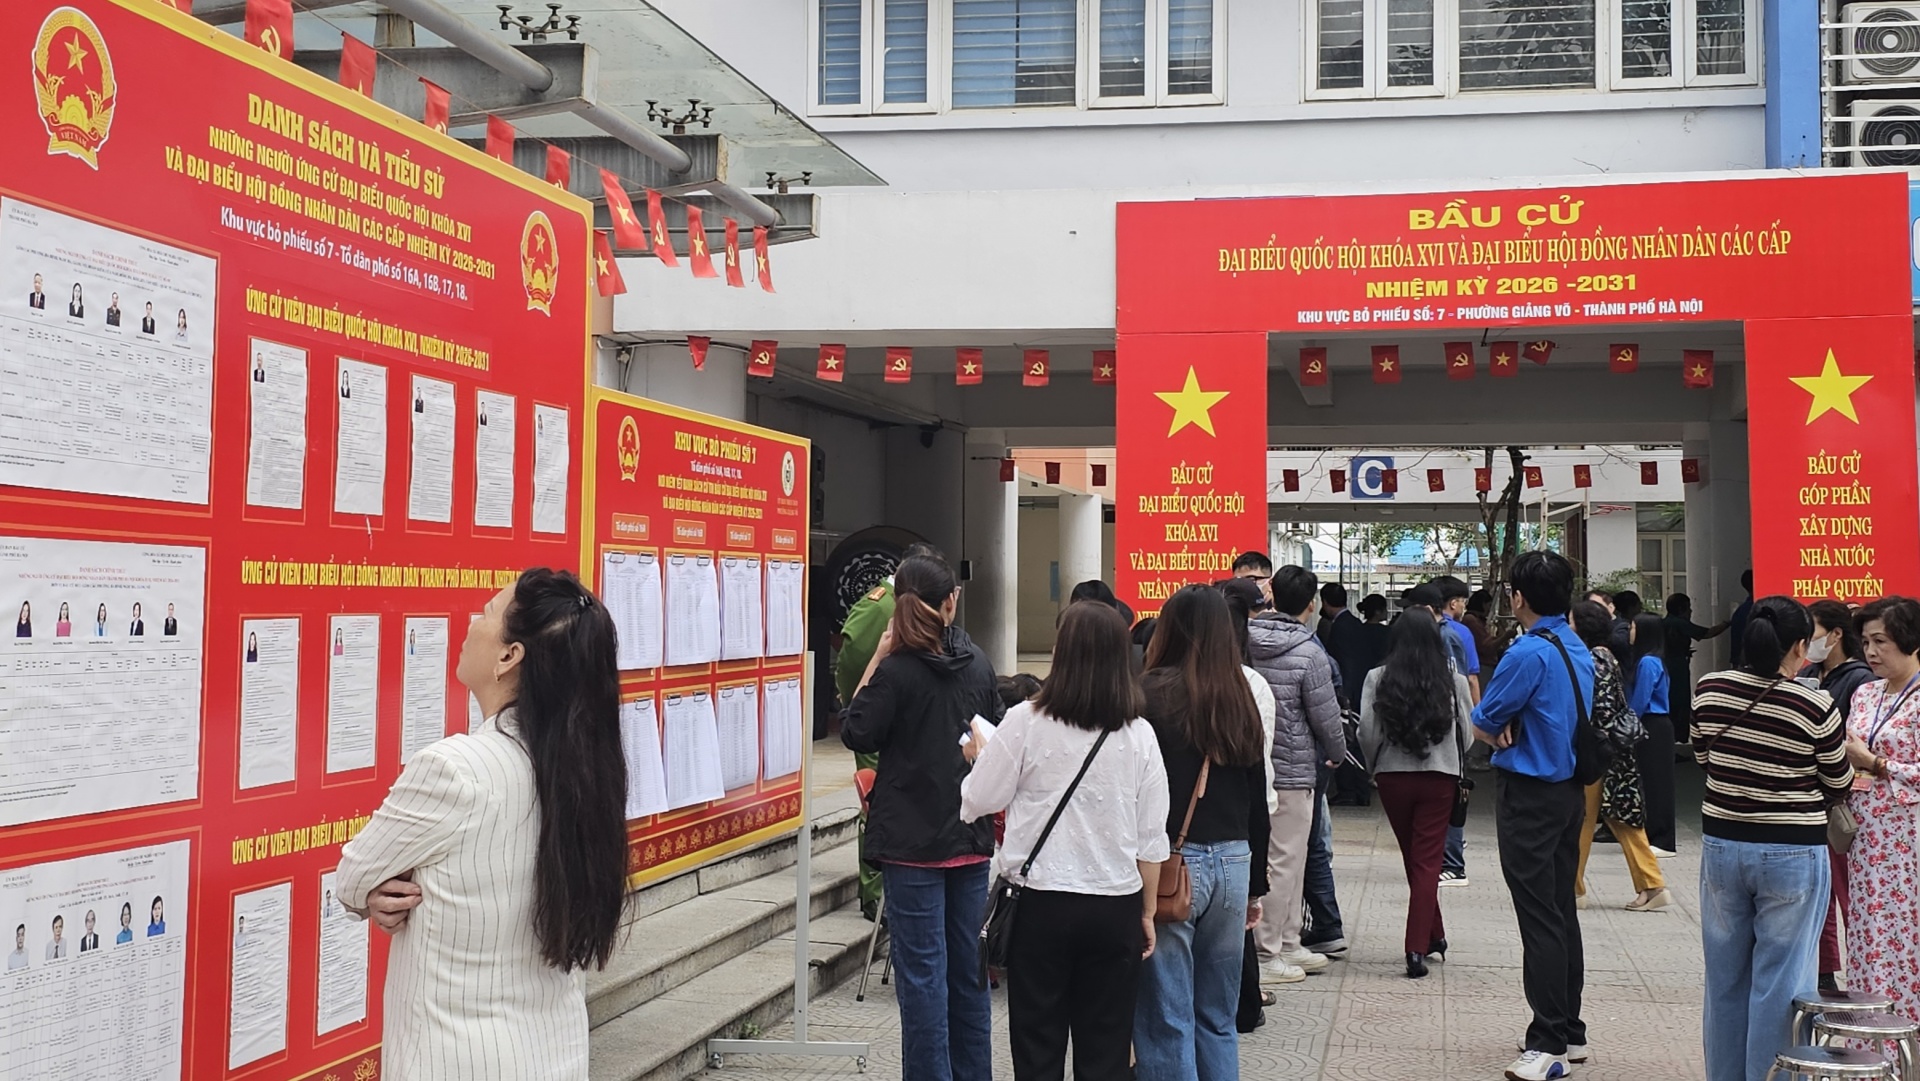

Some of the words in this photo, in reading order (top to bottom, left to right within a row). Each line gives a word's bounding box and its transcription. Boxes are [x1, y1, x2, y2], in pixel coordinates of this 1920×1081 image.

[248, 93, 304, 144] DANH
[308, 120, 354, 164] SÁCH
[358, 140, 381, 175] VÀ
[385, 149, 421, 190] TIỂU
[424, 166, 446, 200] SỬ
[209, 125, 254, 162] NHỮNG
[256, 143, 293, 176] NGƯỜI
[296, 156, 320, 186] ỨNG
[322, 167, 339, 192] CỬ
[340, 176, 358, 203] ĐẠI
[360, 182, 384, 210] BIỂU
[385, 194, 412, 220] QUỐC
[413, 203, 430, 229] HỘI
[431, 212, 455, 238] KHÓA
[456, 221, 472, 243] XVI
[165, 145, 184, 174] VÀ
[187, 154, 210, 185] ĐẠI
[213, 161, 243, 193] BIỂU
[246, 174, 267, 204] HỘI
[270, 181, 302, 214] ĐỒNG
[304, 196, 336, 226] NHÂN
[338, 207, 360, 234] DÂN
[362, 216, 383, 242] CÁC
[385, 223, 405, 248] CẤP
[406, 233, 438, 261] NHIỆM
[439, 243, 451, 265] KỲ
[452, 250, 496, 280] 2026-2031
[1408, 198, 1501, 230] BẦU
[1517, 194, 1585, 226] CỬ
[221, 205, 244, 231] Khu
[245, 218, 265, 241] vực
[267, 220, 281, 243] bỏ
[283, 227, 312, 253] phiếu
[313, 236, 326, 257] số
[327, 241, 334, 259] 7
[339, 244, 351, 265] Tổ
[353, 249, 371, 272] dân
[372, 257, 390, 277] phố
[391, 261, 402, 281] số
[403, 266, 422, 289] 16A,
[423, 272, 442, 295] 16B,
[442, 278, 454, 299] 17,
[456, 283, 468, 301] 18.
[1218, 248, 1246, 278] ĐẠI
[1249, 233, 1287, 271] BIỂU
[1289, 235, 1334, 276] QUỐC
[1337, 237, 1367, 276] HỘI
[1369, 236, 1415, 268] KHÓA
[1416, 242, 1445, 267] XVI
[1447, 234, 1469, 266] VÀ
[1471, 240, 1501, 271] ĐẠI
[1503, 225, 1543, 264] BIỂU
[1546, 230, 1577, 269] HỘI
[1580, 225, 1628, 262] ĐỒNG
[1631, 226, 1678, 260] NHÂN
[1681, 225, 1717, 258] DÂN
[1720, 223, 1754, 256] CÁC
[1757, 218, 1792, 255] CẤP
[1366, 277, 1448, 300] NHIỆM
[1456, 276, 1488, 296] KỲ
[1496, 276, 1558, 295] 2026
[246, 284, 268, 316] ỨNG
[269, 288, 282, 319] CỬ
[283, 296, 306, 325] VIÊN
[306, 303, 322, 332] ĐẠI
[323, 301, 344, 334] BIỂU
[345, 310, 366, 340] QUỐC
[367, 317, 381, 347] HỘI
[382, 323, 403, 350] KHÓA
[404, 330, 419, 357] XVI,
[1297, 310, 1323, 323] KHU
[1325, 309, 1350, 325] VỰC
[1352, 306, 1370, 322] BỎ
[1373, 305, 1410, 322] PHIẾU
[1413, 304, 1434, 321] SỐ:
[1436, 308, 1446, 321] 7
[1457, 304, 1509, 319] PHƯỜNG
[1511, 301, 1552, 318] GIẢNG
[1554, 301, 1572, 317] VÕ
[1583, 300, 1626, 317] THÀNH
[1629, 297, 1656, 315] PHỐ
[1658, 299, 1677, 314] HÀ
[1680, 298, 1703, 315] NỘI
[675, 431, 692, 452] KHU
[692, 434, 708, 457] VỰC
[708, 434, 719, 457] BỎ
[720, 437, 741, 462] PHIẾU
[741, 440, 751, 463] SỐ
[1807, 449, 1837, 474] BẦU
[1840, 449, 1861, 474] CỬ
[1171, 460, 1195, 484] BẦU
[1196, 461, 1213, 484] CỬ
[1357, 460, 1387, 496] C
[1138, 495, 1159, 516] ĐẠI
[1160, 487, 1188, 513] BIỂU
[1190, 488, 1222, 516] QUỐC
[1223, 491, 1245, 516] HỘI
[1799, 482, 1829, 505] GÓP
[1831, 479, 1871, 505] PHẦN
[1165, 520, 1197, 542] KHÓA
[1199, 524, 1218, 542] XVI
[1799, 513, 1828, 536] XÂY
[1830, 515, 1873, 540] DỰNG
[1129, 548, 1145, 570] VÀ
[1146, 553, 1167, 574] ĐẠI
[1169, 545, 1196, 570] BIỂU
[1198, 549, 1219, 574] HỘI
[1800, 544, 1832, 567] NHÀ
[1833, 543, 1875, 567] NƯỚC
[241, 555, 263, 585] ỨNG
[264, 554, 278, 585] CỬ
[279, 557, 302, 585] VIÊN
[302, 562, 318, 590] ĐẠI
[319, 553, 340, 586] BIỂU
[341, 560, 356, 591] HỘI
[356, 556, 378, 587] ĐỒNG
[379, 561, 402, 587] NHÂN
[403, 562, 419, 587] DÂN
[1792, 574, 1831, 598] PHÁP
[1833, 571, 1884, 601] QUYỀN
[1138, 577, 1170, 599] NHÂN
[232, 836, 253, 865] ỨNG
[255, 828, 269, 860] CỬ
[270, 827, 293, 857] VIÊN
[293, 827, 310, 855] ĐẠI
[311, 814, 332, 849] BIỂU
[333, 816, 347, 847] HỘI
